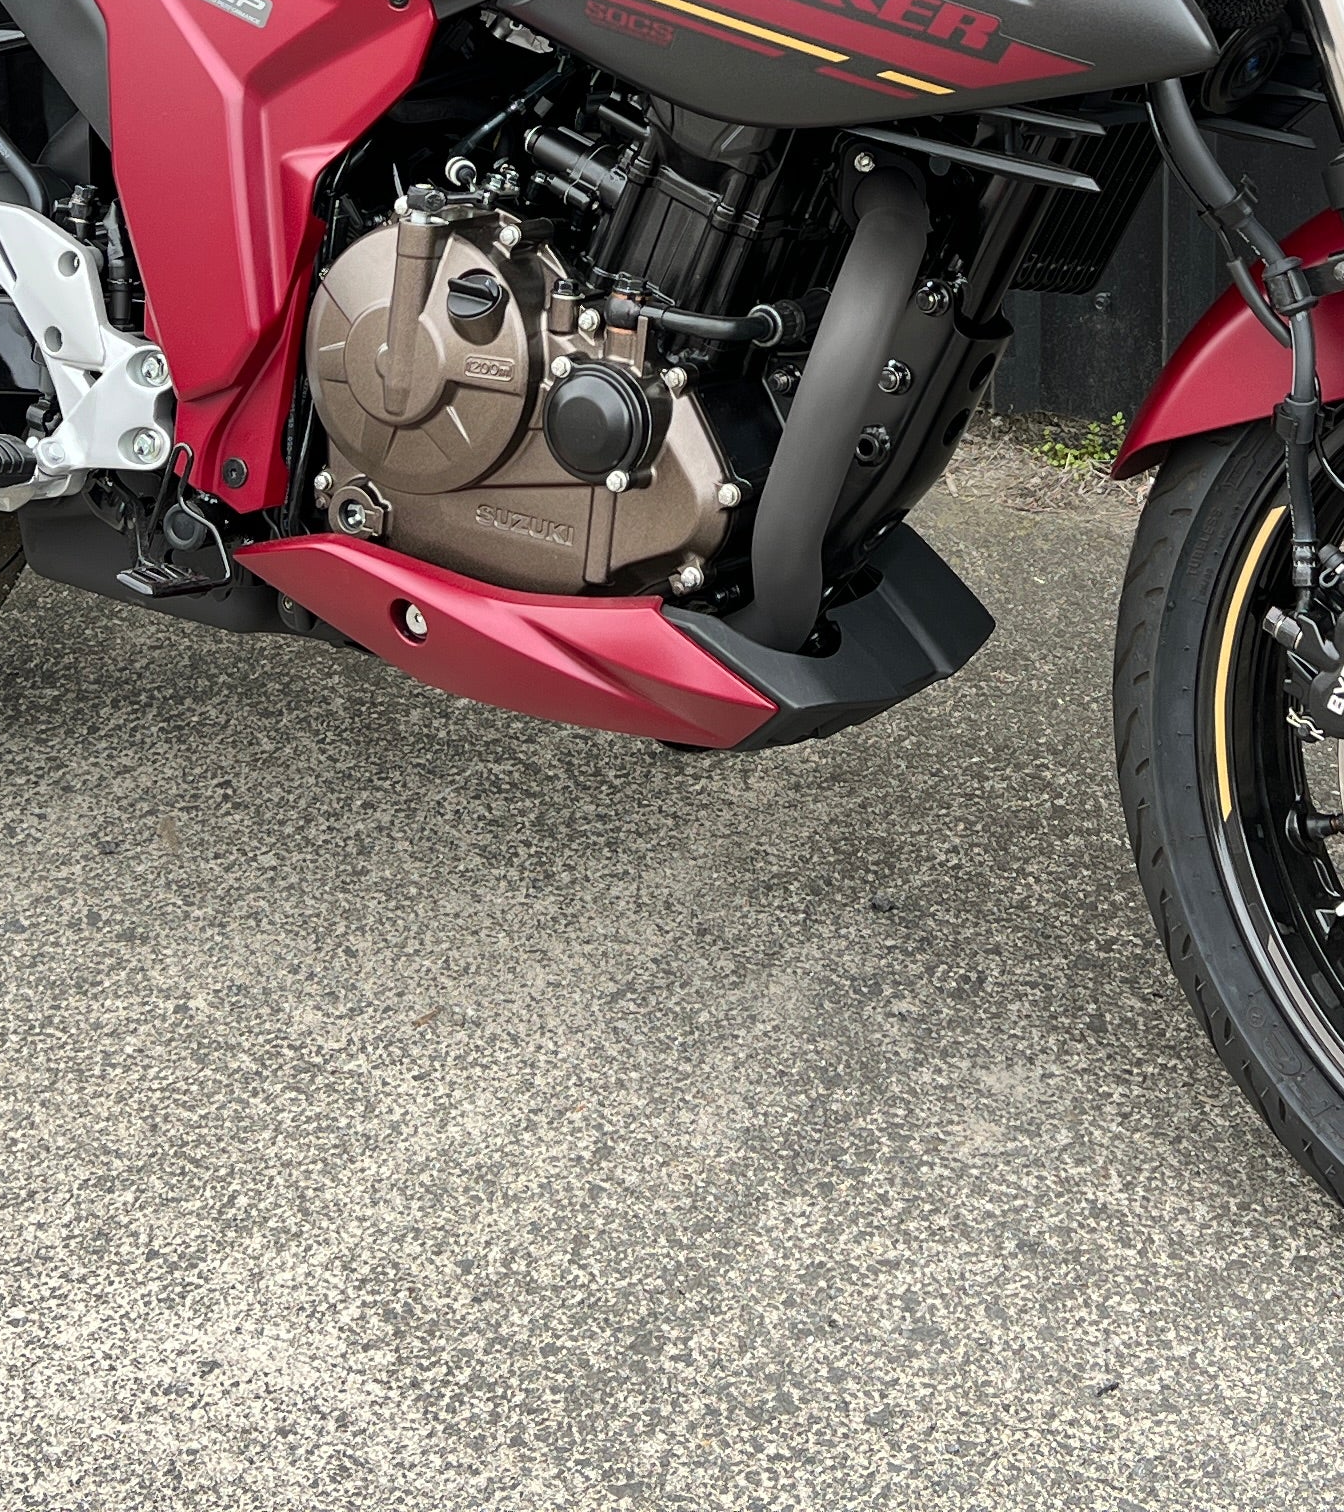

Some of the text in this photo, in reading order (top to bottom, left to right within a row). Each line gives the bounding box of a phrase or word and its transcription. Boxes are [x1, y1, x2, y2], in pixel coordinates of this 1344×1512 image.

[585, 0, 674, 43] SOCS
[475, 504, 575, 547] SUZUKI
[1186, 504, 1223, 580] TUBELESS
